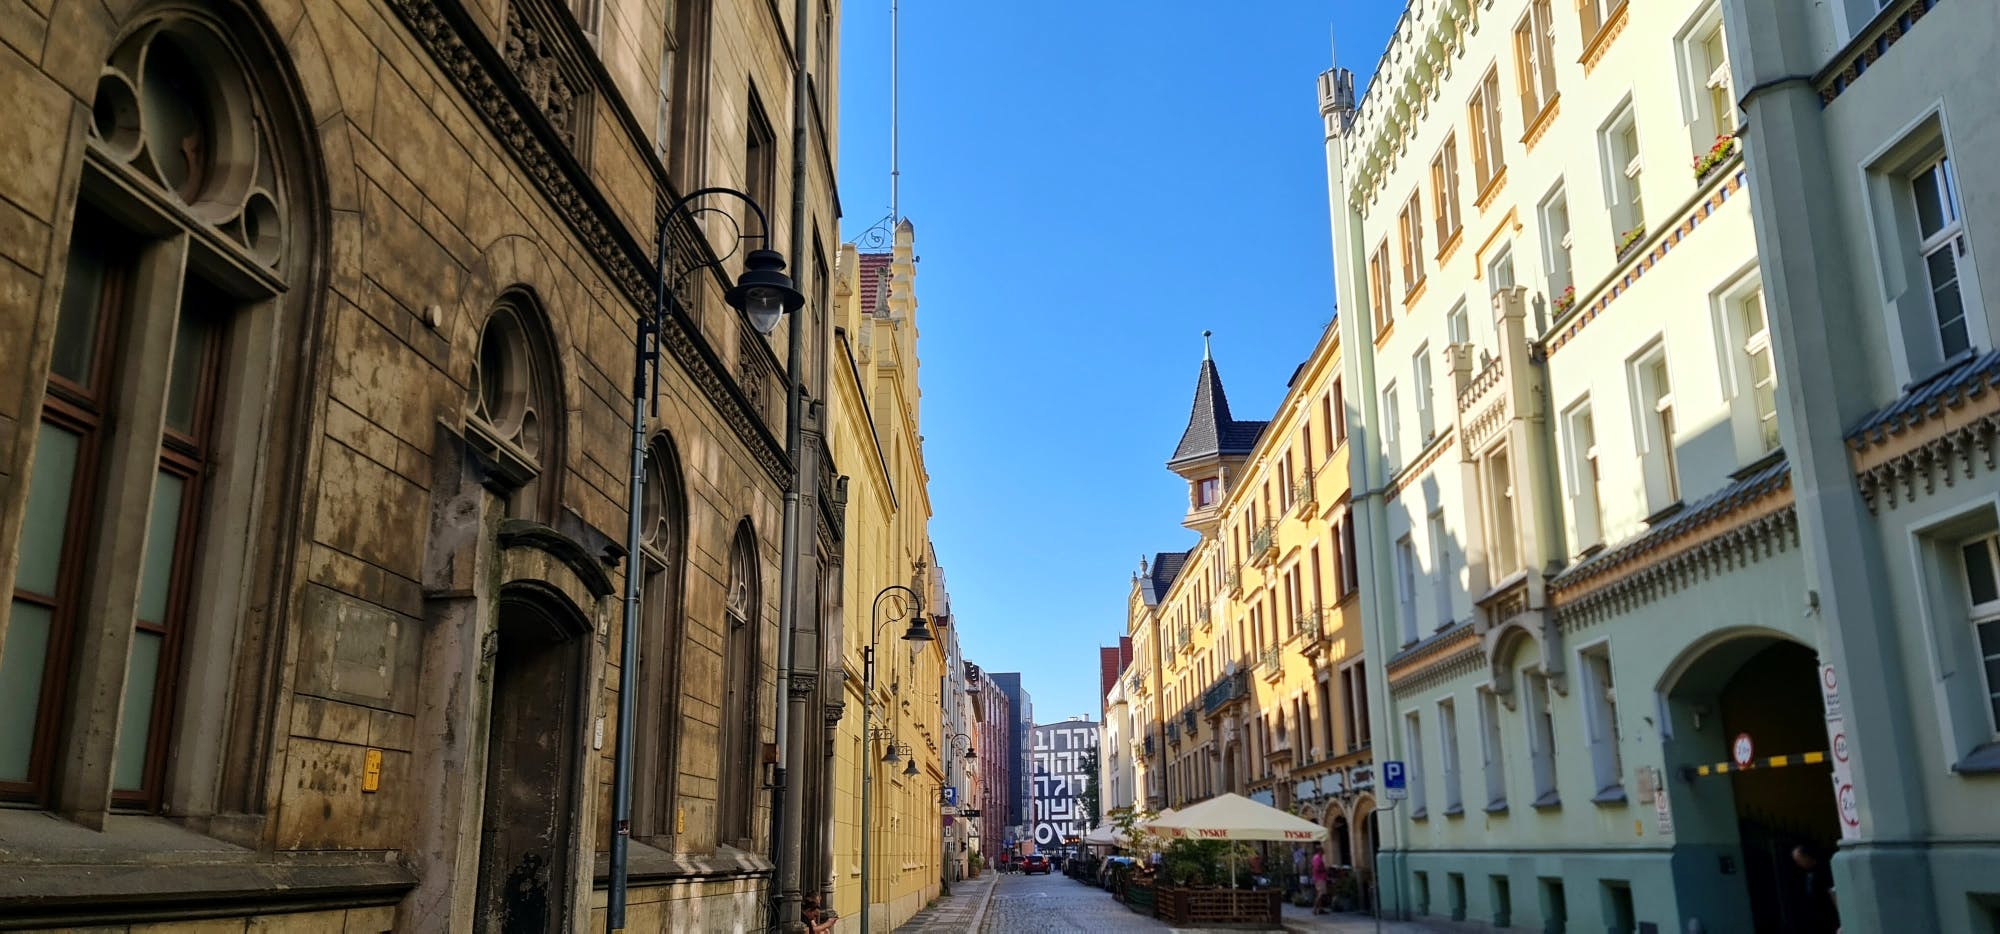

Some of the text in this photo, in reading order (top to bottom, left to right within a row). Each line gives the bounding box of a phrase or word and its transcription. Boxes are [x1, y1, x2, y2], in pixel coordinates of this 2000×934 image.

[1387, 763, 1401, 780] P
[1199, 828, 1227, 838] TYSKIE
[1283, 830, 1312, 839] TYSKIE
